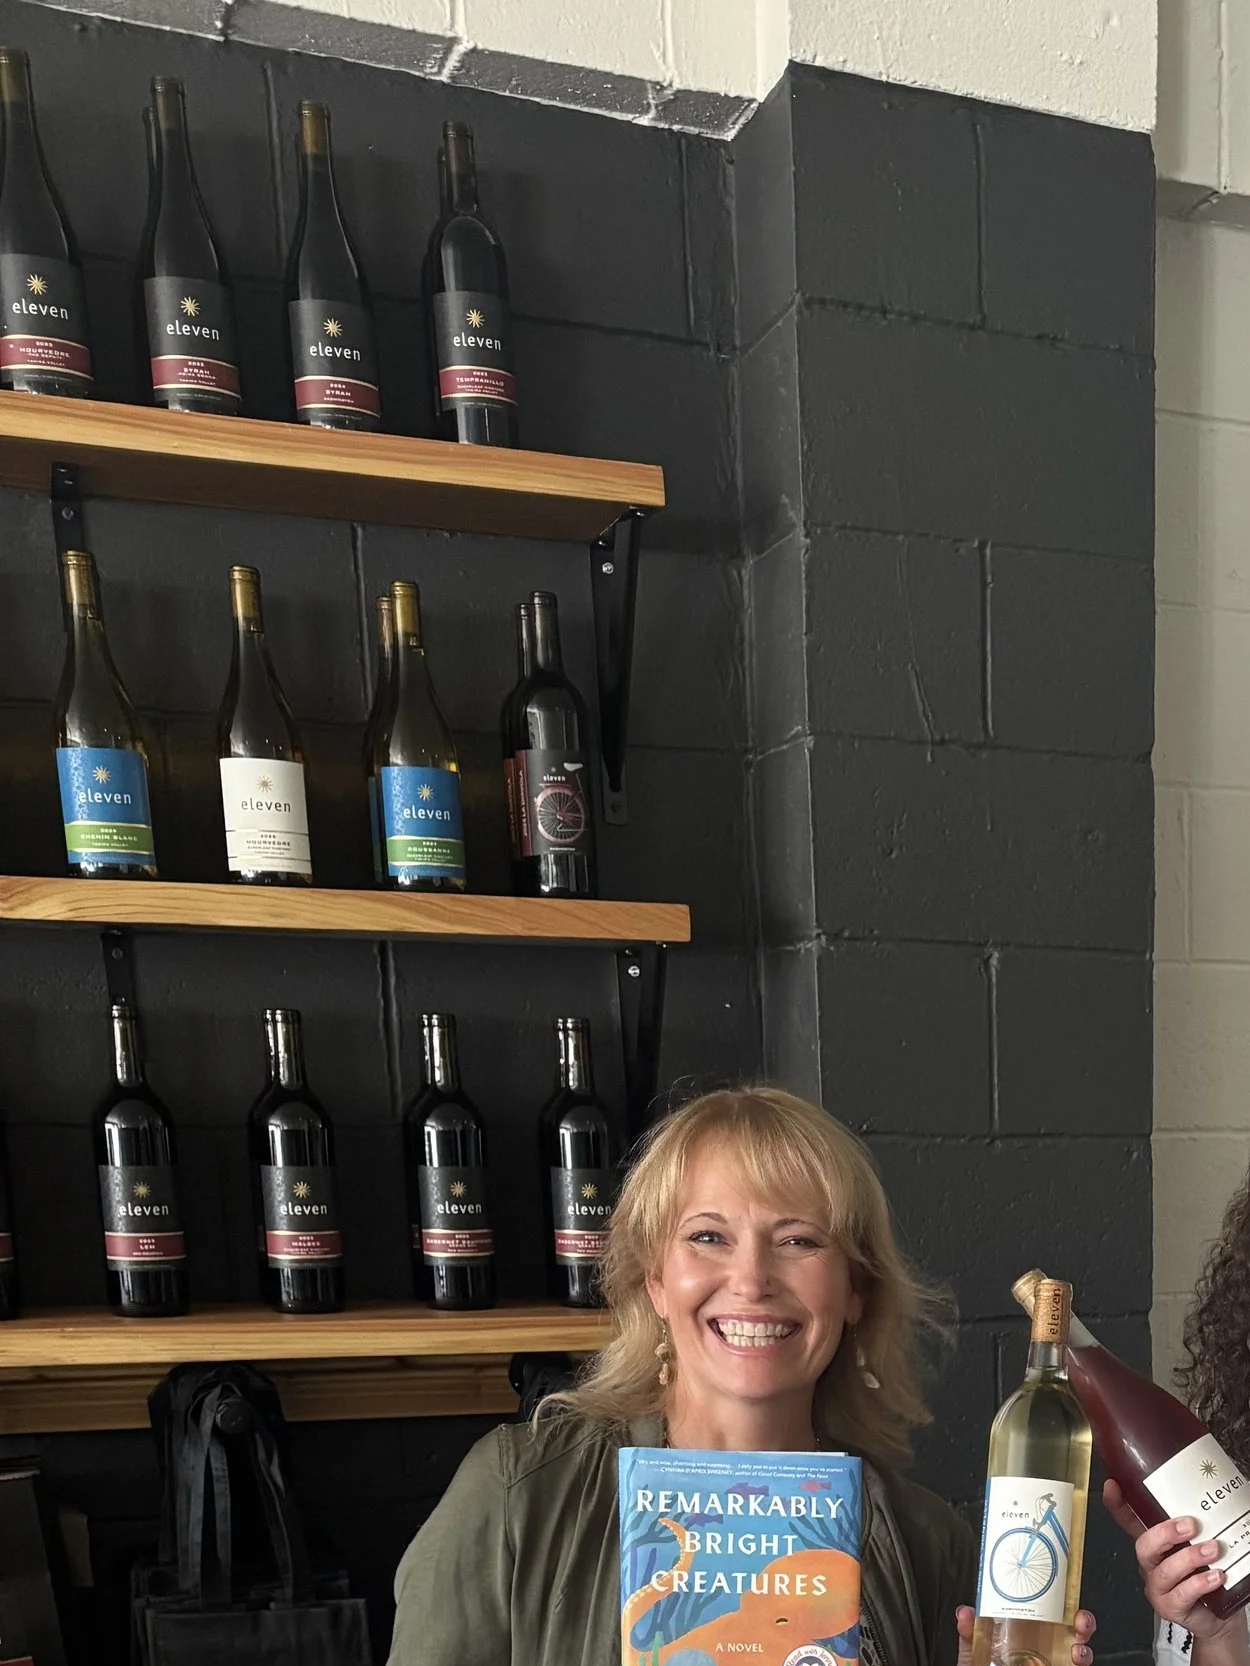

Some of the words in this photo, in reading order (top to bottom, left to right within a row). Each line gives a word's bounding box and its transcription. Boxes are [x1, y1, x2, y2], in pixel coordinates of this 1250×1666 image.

[12, 298, 69, 320] eleven
[166, 319, 220, 341] eleven
[453, 332, 502, 351] eleven
[309, 341, 361, 361] eleven
[78, 789, 132, 805] eleven
[241, 798, 292, 814] eleven
[403, 806, 451, 822] eleven
[119, 1202, 169, 1217] eleven
[280, 1202, 328, 1216] eleven
[437, 1201, 482, 1215] eleven
[567, 1202, 612, 1217] eleven
[1049, 1286, 1062, 1336] eleven
[1200, 1474, 1245, 1513] eleven
[636, 1489, 844, 1519] REMARKABLY
[1001, 1509, 1030, 1520] eleven
[684, 1531, 798, 1556] BRIGHT
[1228, 1538, 1239, 1550] LA
[651, 1570, 827, 1596] CREATURES
[715, 1643, 724, 1653] A
[727, 1643, 764, 1653] NOVEL
